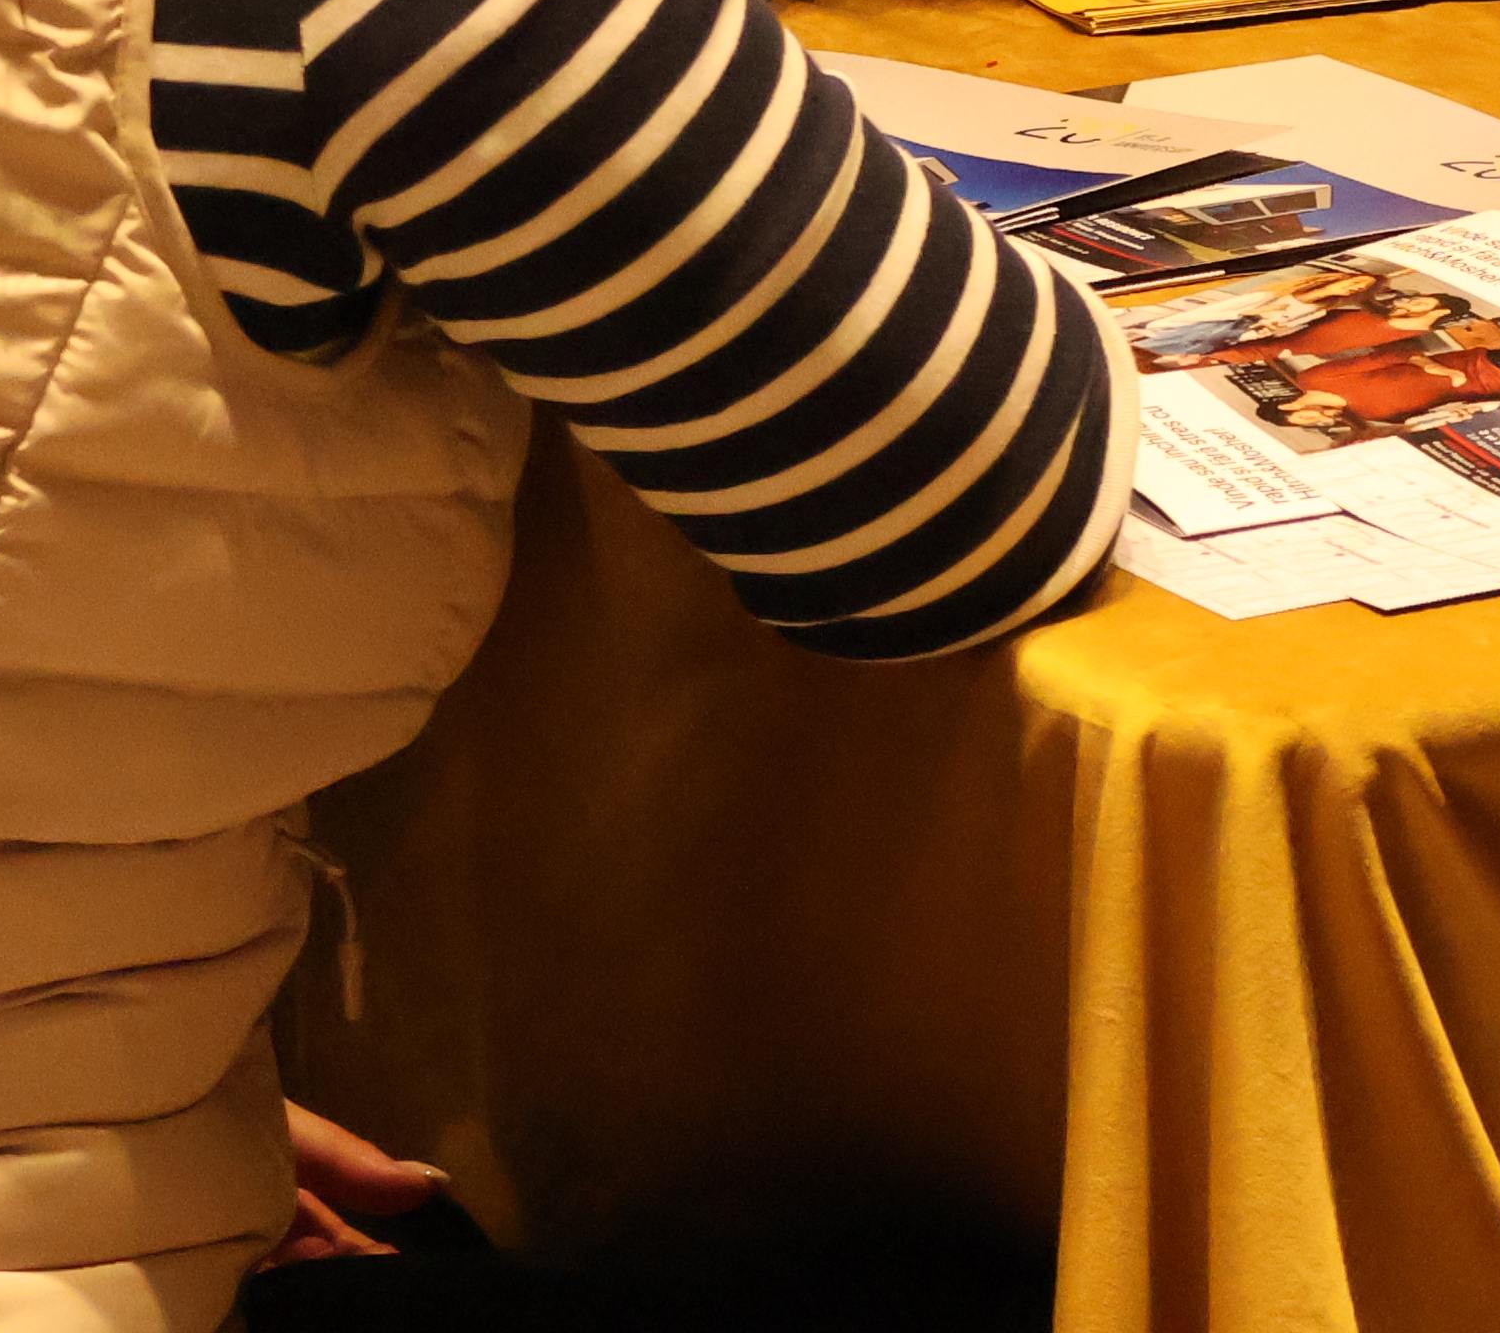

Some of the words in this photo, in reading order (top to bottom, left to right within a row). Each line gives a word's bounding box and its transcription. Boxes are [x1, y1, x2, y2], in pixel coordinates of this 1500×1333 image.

[1141, 404, 1172, 420] cu
[1161, 418, 1208, 454] stres
[1179, 457, 1216, 477] sau
[1198, 444, 1238, 471] fără
[1207, 477, 1257, 511] Vinde
[1242, 476, 1292, 506] rapid
